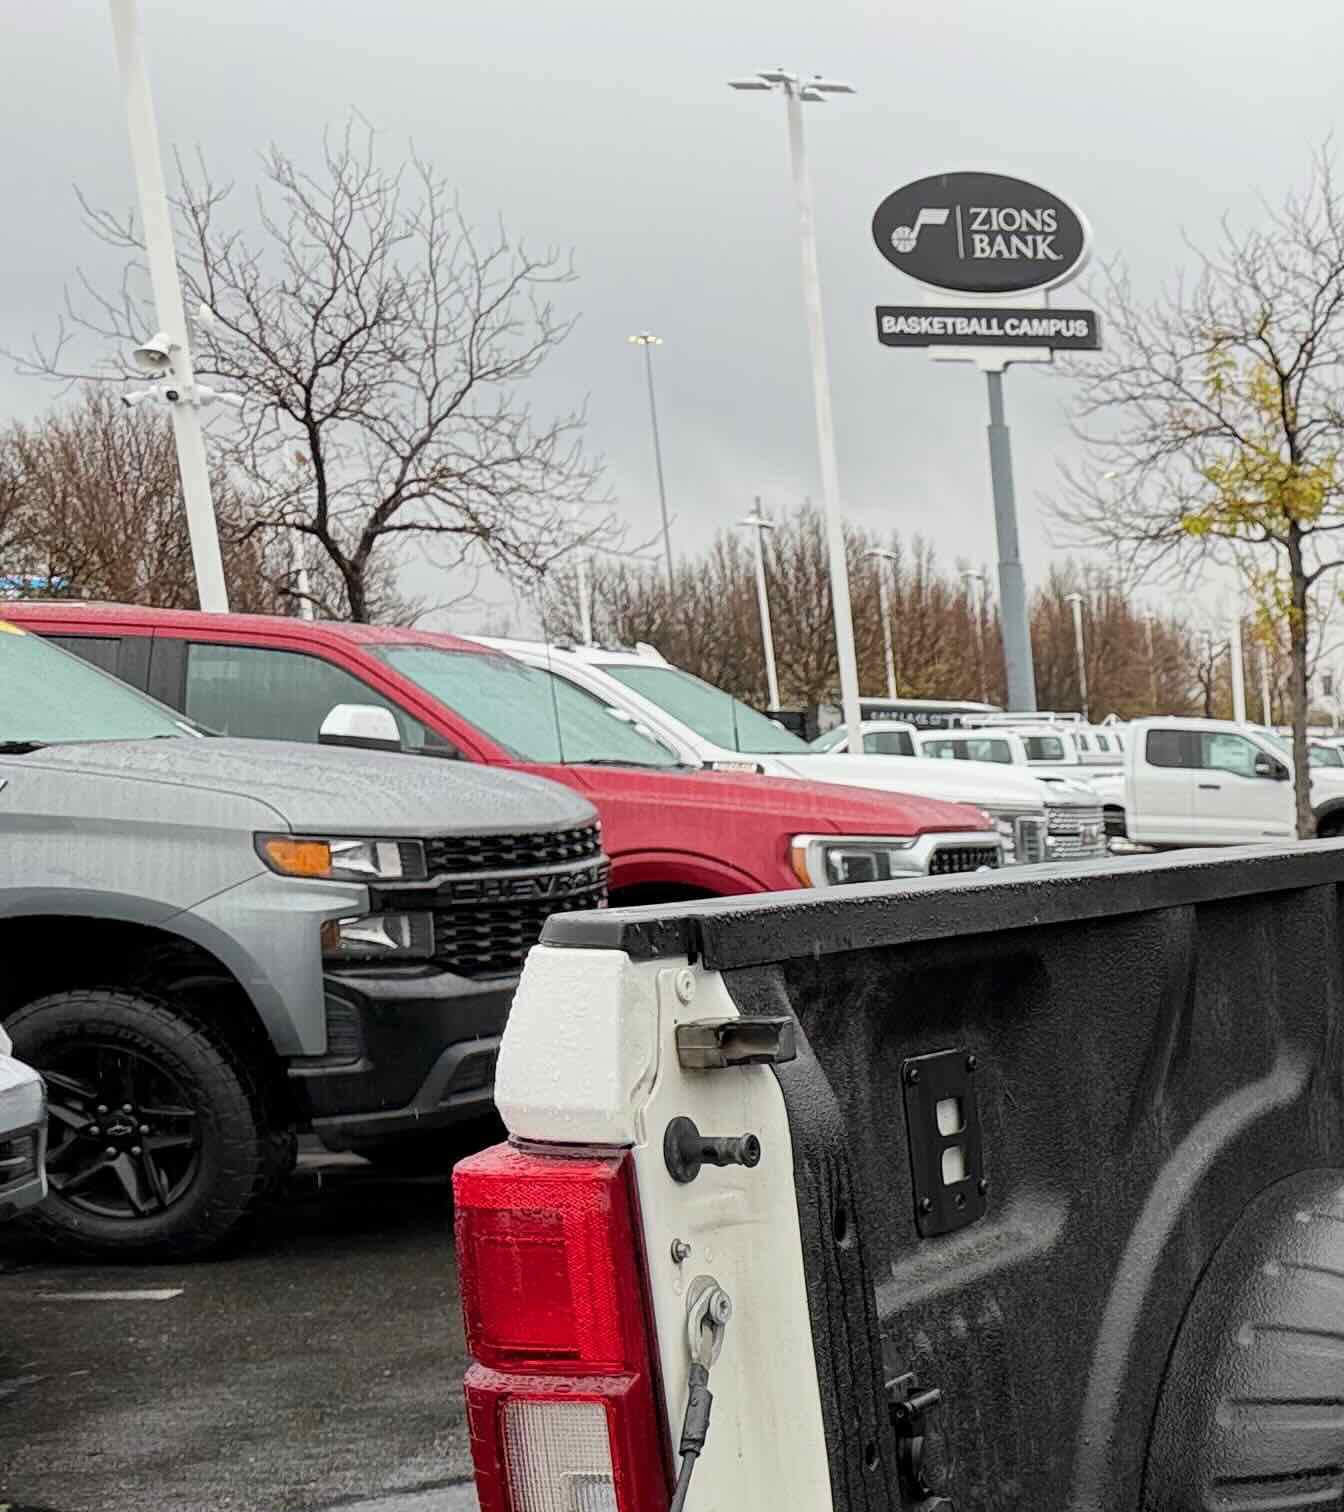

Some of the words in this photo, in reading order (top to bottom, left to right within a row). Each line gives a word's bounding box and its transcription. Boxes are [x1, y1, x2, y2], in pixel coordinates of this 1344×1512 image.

[969, 207, 1058, 232] ZIONS
[972, 233, 1064, 261] BANK
[881, 315, 1004, 335] BASKETBALL
[1004, 318, 1089, 337] CAMPUS
